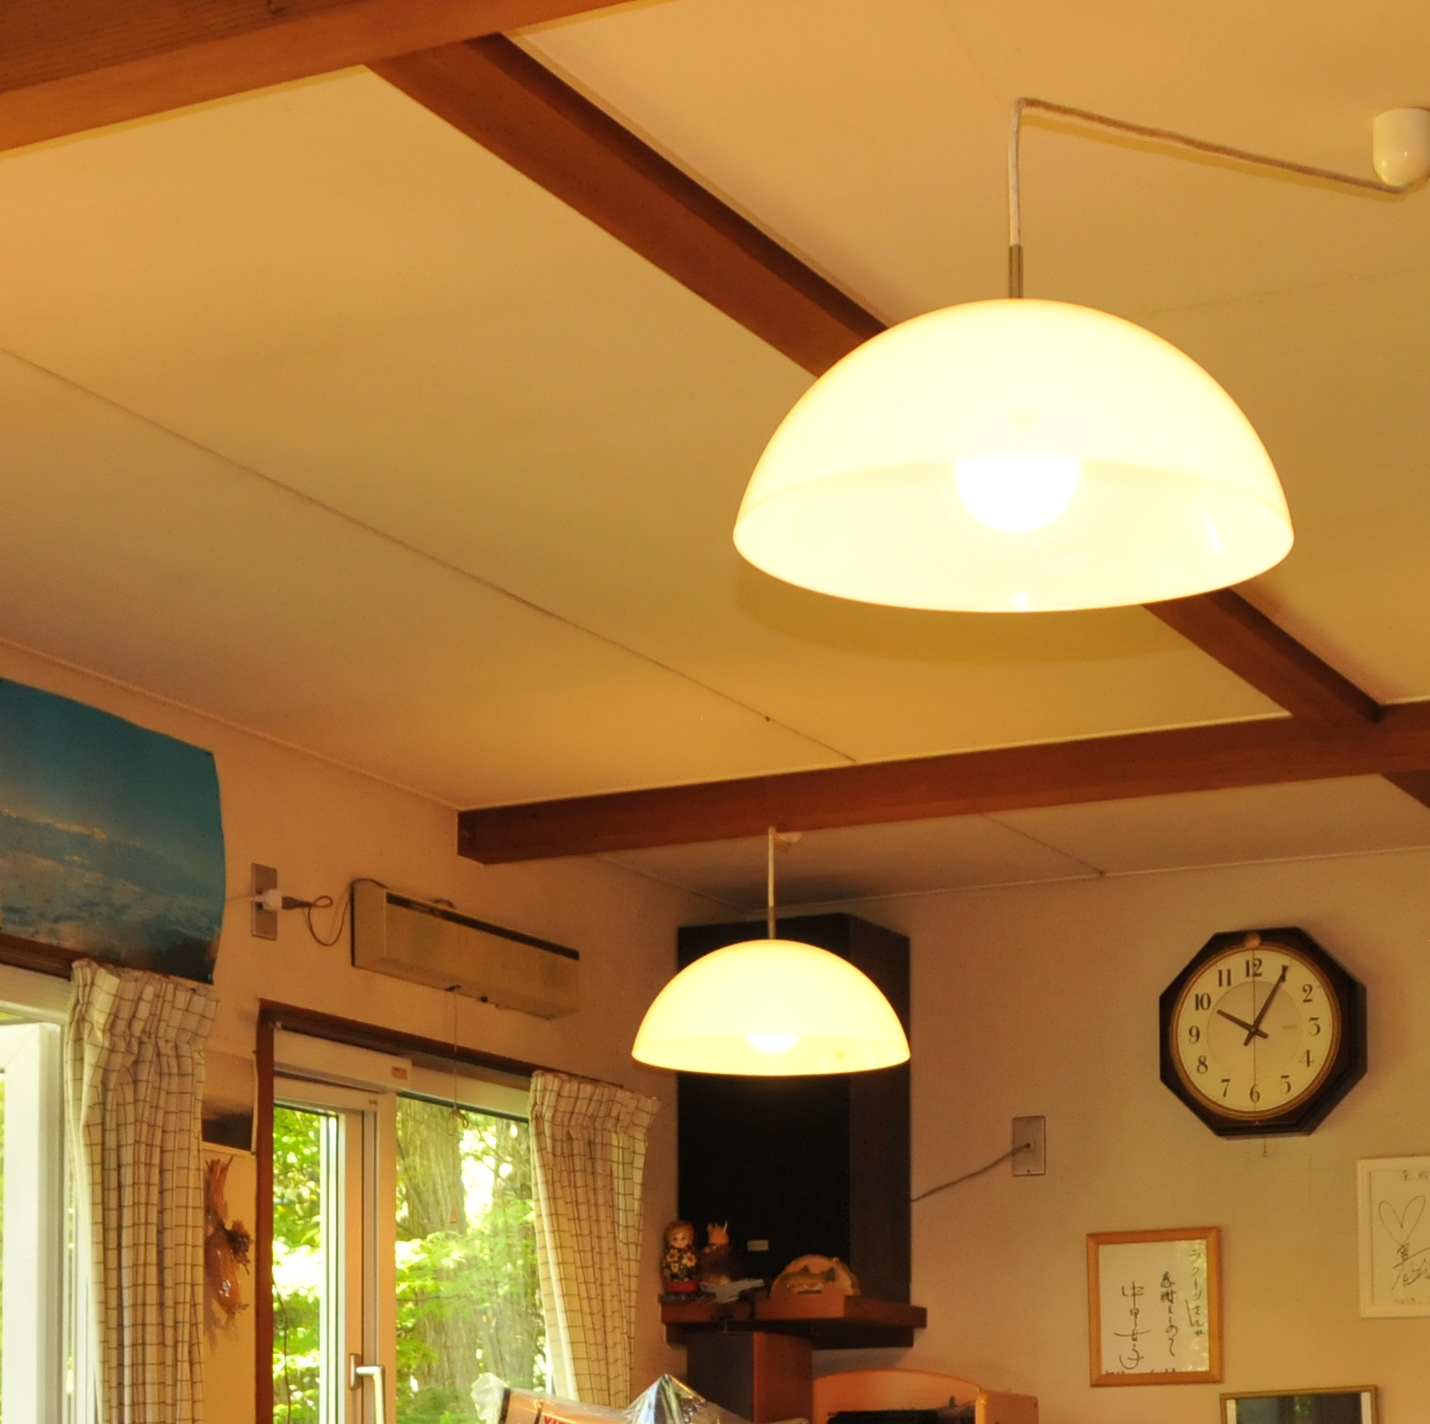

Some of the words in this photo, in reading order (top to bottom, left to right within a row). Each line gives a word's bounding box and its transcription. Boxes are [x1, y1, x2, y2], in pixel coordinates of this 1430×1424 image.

[1245, 958, 1263, 977] 12
[1218, 969, 1232, 987] 11
[1195, 993, 1212, 1011] 10
[1302, 984, 1313, 1002] 2
[1188, 1026, 1200, 1044] 9
[1308, 1017, 1321, 1036] 3
[1196, 1056, 1209, 1074] 8
[1299, 1049, 1315, 1068] 4
[1221, 1079, 1231, 1098] 7
[1249, 1084, 1260, 1103] 6
[1280, 1075, 1292, 1094] 5
